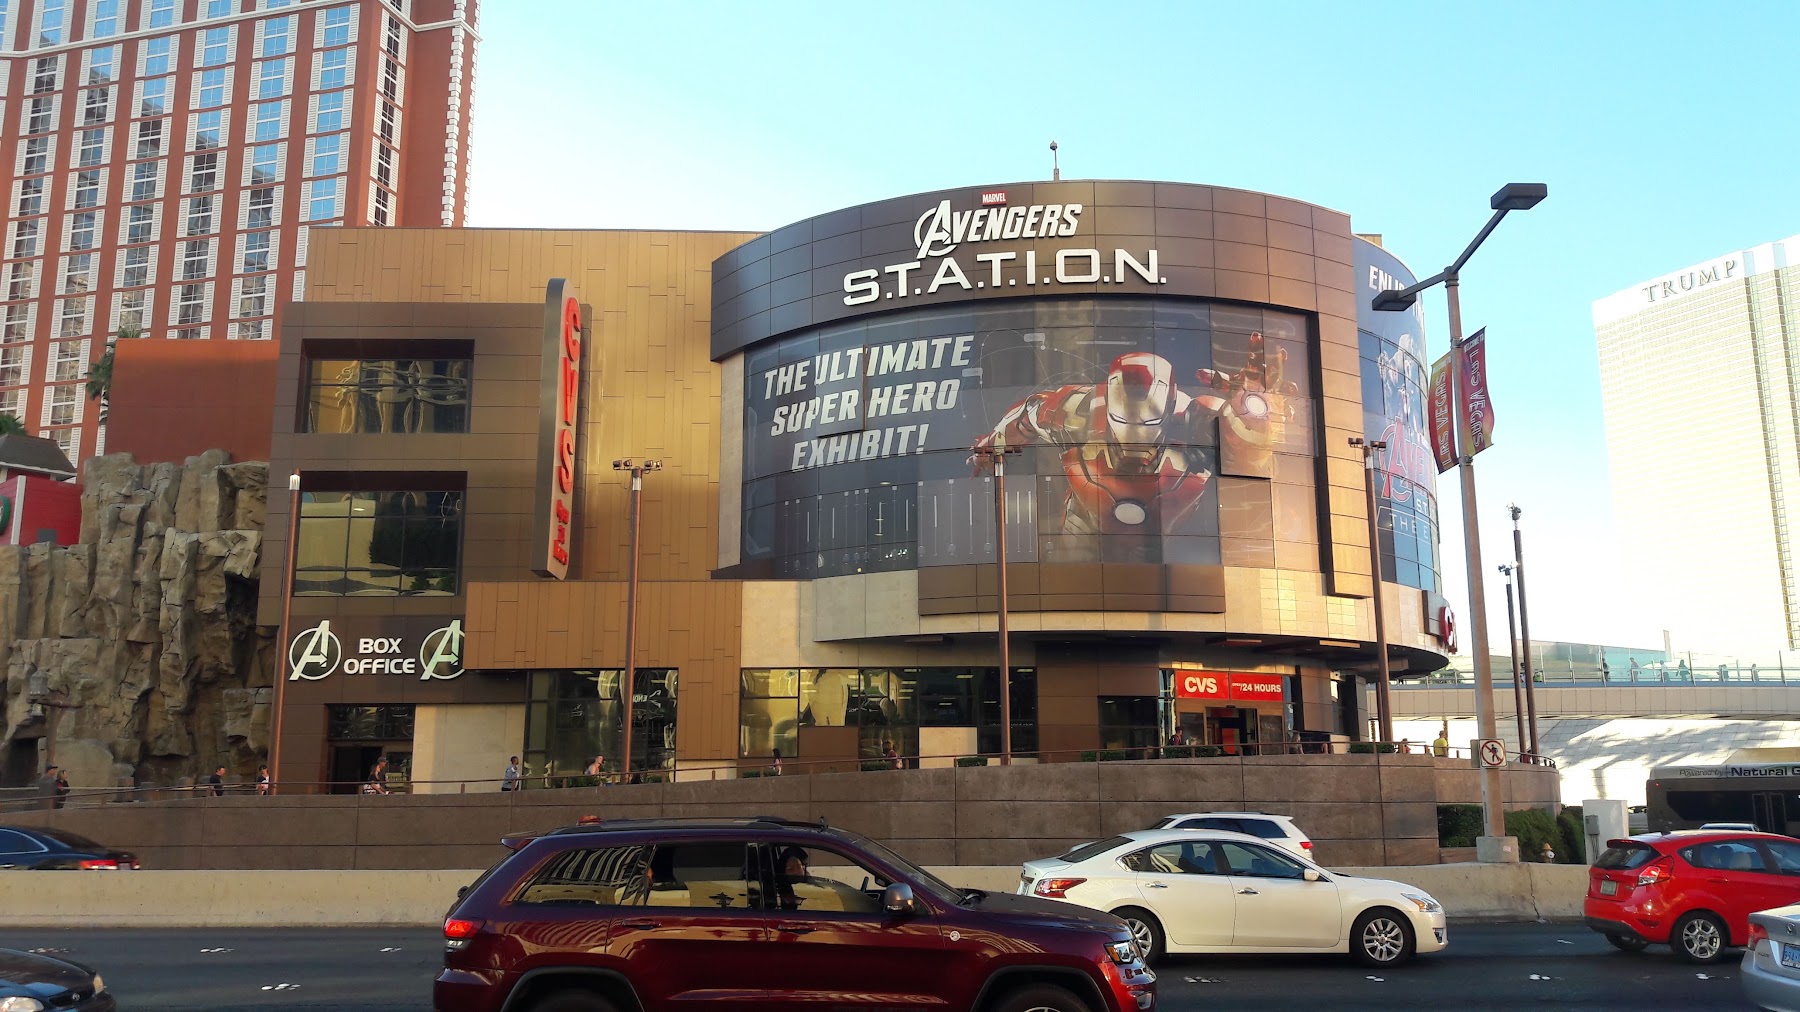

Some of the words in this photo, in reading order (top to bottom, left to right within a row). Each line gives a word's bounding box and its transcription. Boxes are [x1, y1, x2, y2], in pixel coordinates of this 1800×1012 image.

[982, 192, 1006, 203] MARVEL
[914, 199, 1083, 259] AVENGERS
[843, 249, 1167, 306] S.T.A.T.I.O.N.
[1641, 260, 1738, 303] TRUMP
[764, 360, 811, 400] THE
[814, 335, 975, 386] ULTIMATE
[1469, 349, 1482, 387] LAS
[557, 297, 581, 494] CVS
[770, 389, 859, 437] SUPER
[867, 379, 961, 419] HERO
[1435, 372, 1449, 430] VEGAS
[1469, 388, 1486, 447] VEGAS
[791, 423, 930, 473] EXHIBIT!
[1437, 430, 1452, 466] LAS
[343, 658, 416, 675] OFFICE
[358, 637, 402, 654] BOX
[1184, 676, 1218, 694] CVS
[1254, 683, 1281, 693] HOURS
[1731, 765, 1788, 777] Natural
